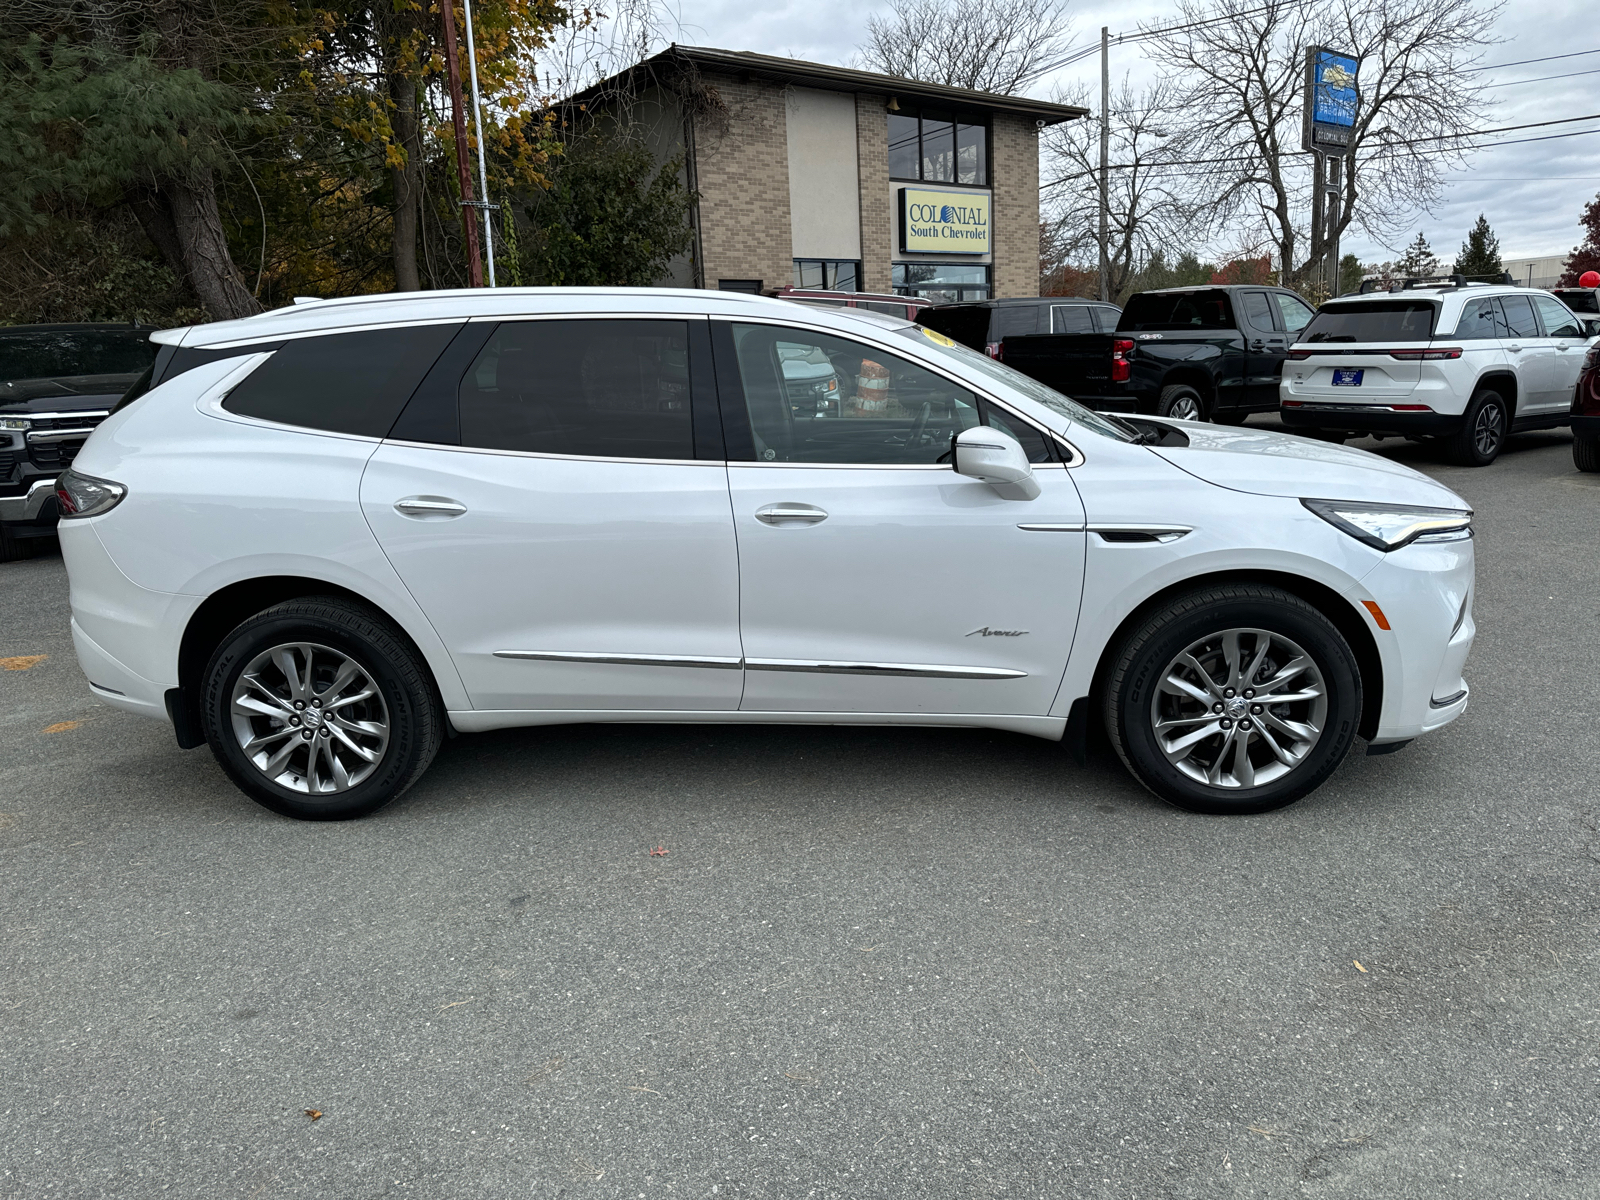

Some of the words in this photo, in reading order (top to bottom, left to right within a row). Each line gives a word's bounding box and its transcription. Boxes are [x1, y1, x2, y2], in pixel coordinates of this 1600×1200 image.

[910, 203, 986, 225] COLONIAL
[911, 224, 939, 238] South
[941, 226, 986, 239] Chevrolet
[965, 626, 1030, 637] Avenir
[380, 679, 408, 787] CONTINENTAL
